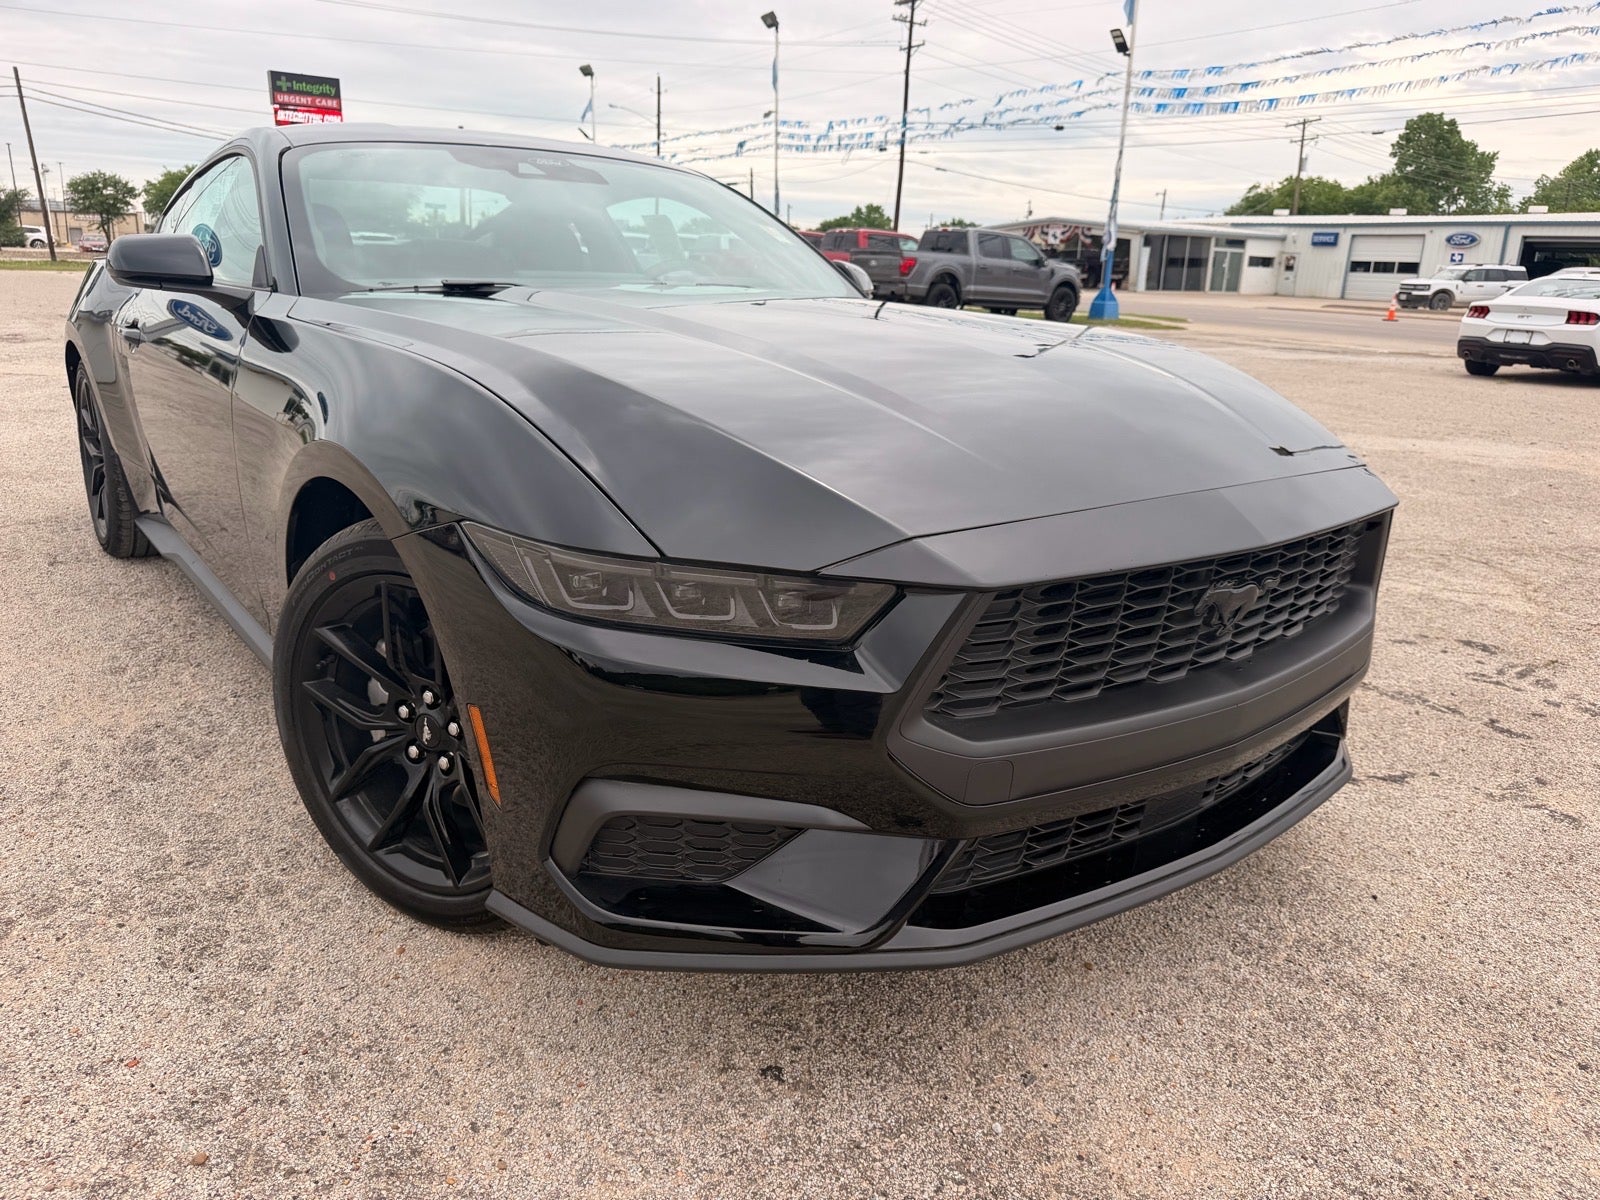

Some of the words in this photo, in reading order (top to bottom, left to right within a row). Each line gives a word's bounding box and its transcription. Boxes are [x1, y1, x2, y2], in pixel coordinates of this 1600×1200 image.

[292, 80, 336, 96] Integrity
[277, 94, 312, 105] URGENT
[315, 98, 338, 108] CARE
[1450, 234, 1472, 245] Ford
